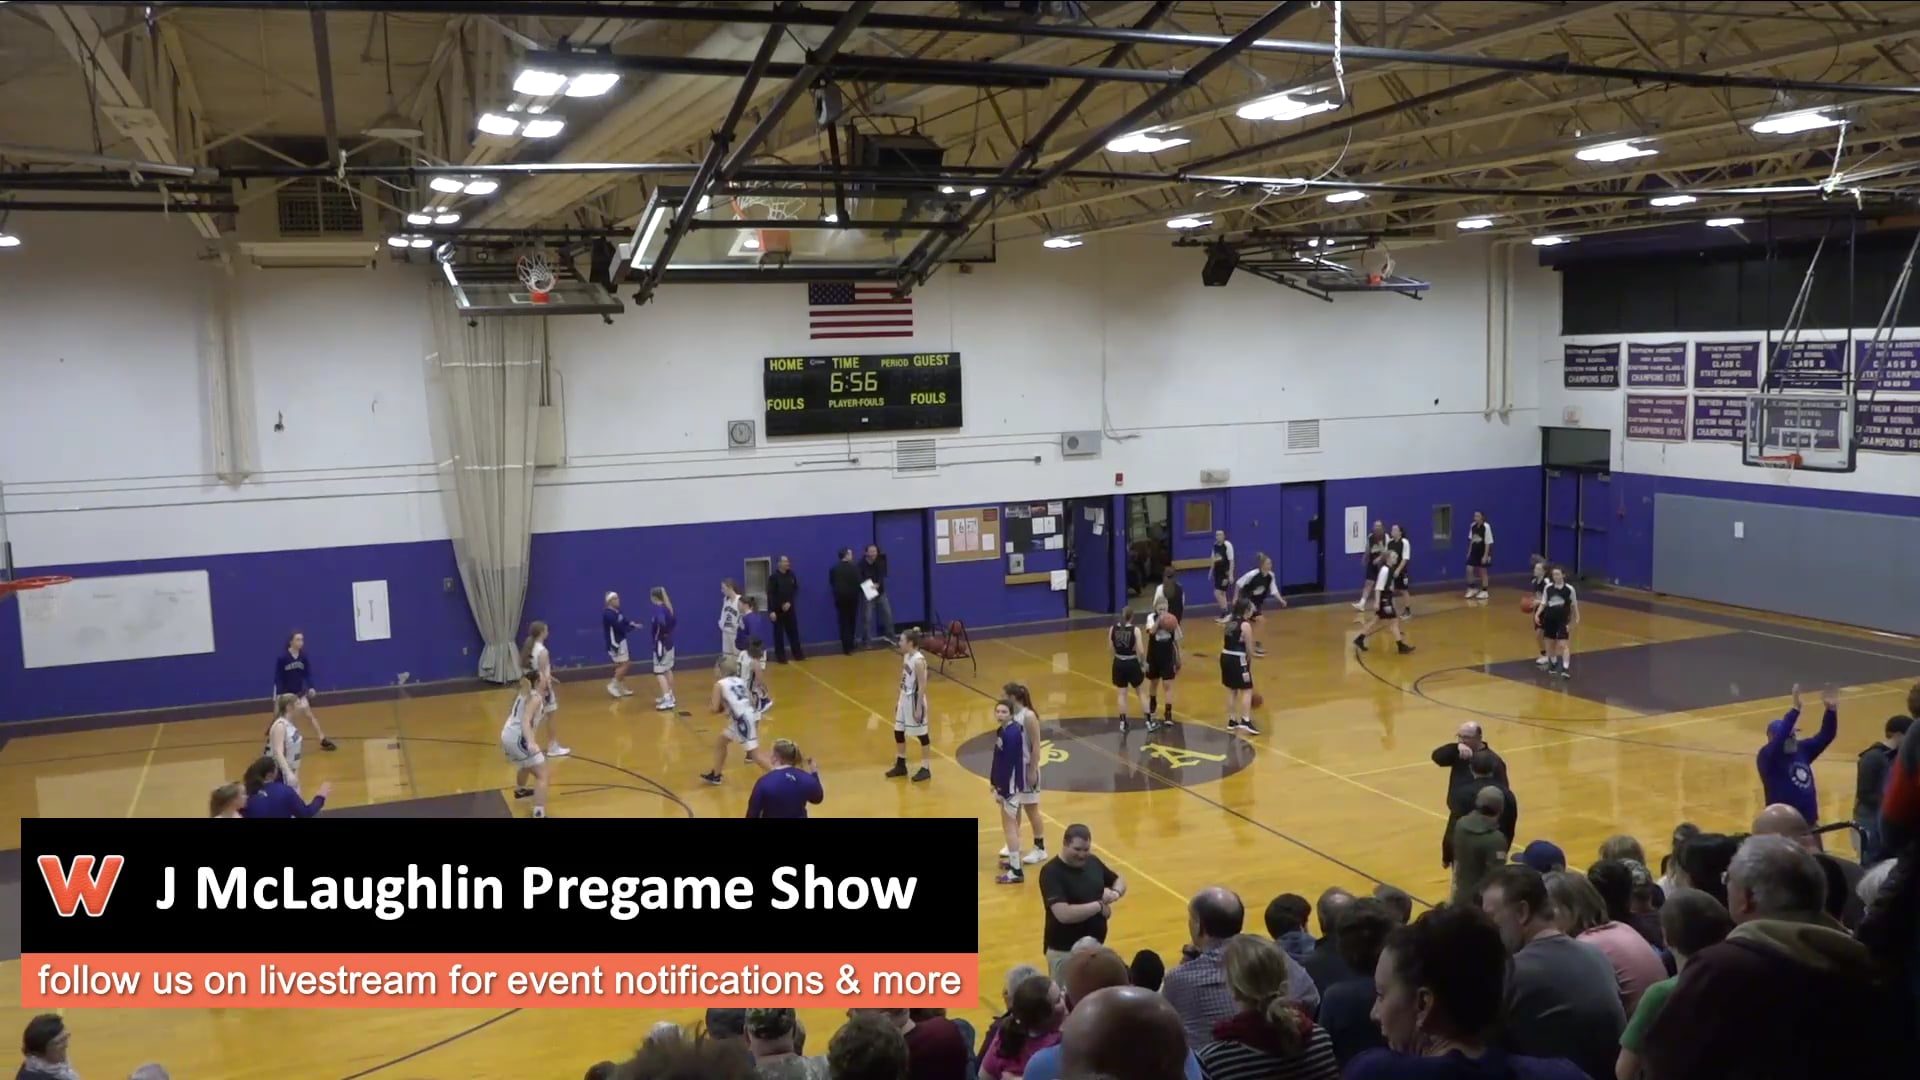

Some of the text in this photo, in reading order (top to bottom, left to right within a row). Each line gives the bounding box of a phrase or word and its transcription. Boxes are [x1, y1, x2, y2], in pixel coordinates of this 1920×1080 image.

[770, 358, 804, 371] HOME
[832, 357, 860, 369] TIME
[881, 358, 909, 368] PERIOD
[913, 354, 950, 367] GUEST
[830, 371, 878, 392] 6:56
[767, 398, 805, 410] FOULS
[910, 392, 946, 405] FOULS
